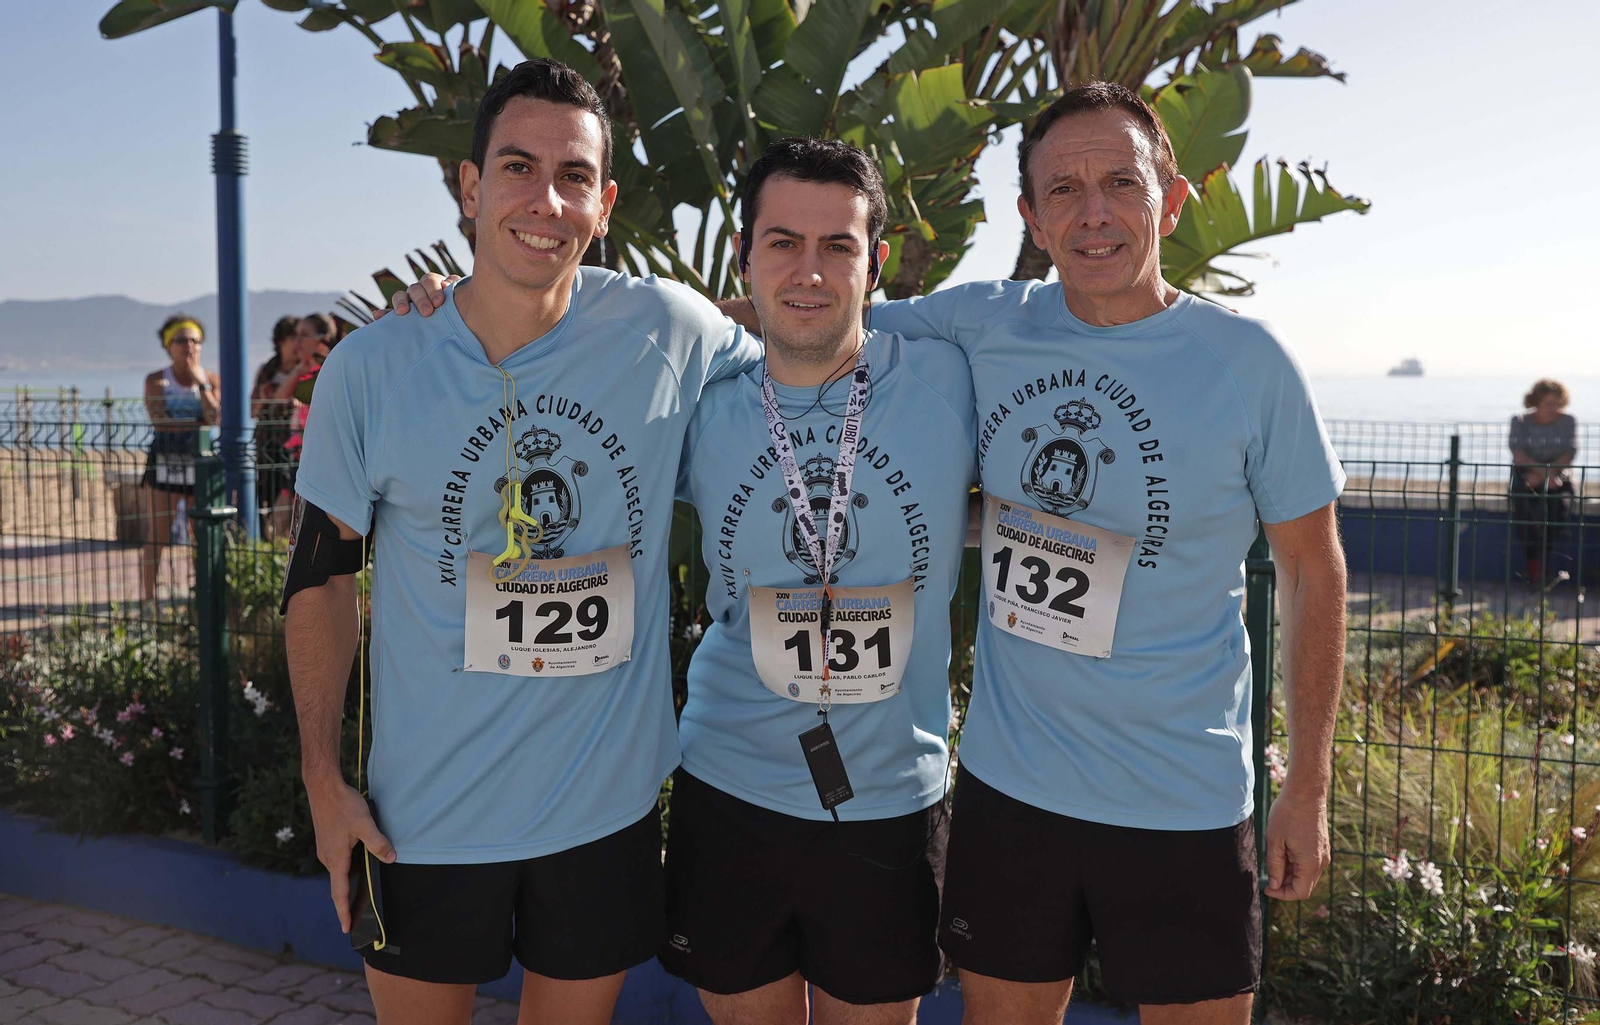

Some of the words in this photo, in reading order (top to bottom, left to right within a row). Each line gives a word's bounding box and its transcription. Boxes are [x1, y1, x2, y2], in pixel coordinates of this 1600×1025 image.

[1012, 369, 1085, 406] URBANA
[1094, 374, 1152, 432] CIUDAD
[460, 399, 528, 462] URBANA
[536, 394, 604, 434] CIUDAD
[844, 418, 858, 444] LOBO
[601, 433, 626, 460] DE
[750, 426, 816, 480] URBNA
[826, 425, 890, 470] CIDAD
[1138, 439, 1164, 464] DE
[885, 470, 912, 496] DE
[442, 470, 472, 545] CARRERA
[617, 466, 643, 559] ALGECIRAS
[718, 484, 754, 559] CARRERA
[1000, 502, 1012, 513] XXIV
[1012, 507, 1032, 519] EDICIÓN
[1138, 476, 1170, 569] ALGECIRAS
[900, 503, 930, 592] ALGECIRAS
[996, 524, 1027, 544] CIUDAD
[1028, 535, 1042, 549] DE
[1041, 539, 1096, 565] ALGECIRAS
[998, 511, 1044, 536] CARRERA
[1046, 526, 1097, 551] URBANA
[438, 548, 456, 587] XXIV
[496, 582, 538, 594] CIUDAD
[541, 583, 555, 594] DE
[556, 574, 608, 593] ALGECIRAS
[560, 561, 608, 581] URBANA
[720, 563, 738, 600] XXIV
[992, 546, 1090, 619] 132
[792, 591, 817, 599] EDICIÓN
[836, 596, 891, 609] URBANA
[994, 593, 1007, 603] LUQUE
[1007, 599, 1020, 608] PIÑA,
[1021, 604, 1050, 618] FRANCISCO
[1052, 614, 1072, 624] JAVIER
[496, 595, 609, 644] 129
[778, 612, 818, 623] CIUDAD
[835, 609, 891, 622] ALGECIRAS
[1020, 619, 1046, 631] Ayuntamiento
[1027, 625, 1043, 635] Algeciras
[563, 644, 596, 652] ALEJANDRO
[785, 626, 891, 672] 131
